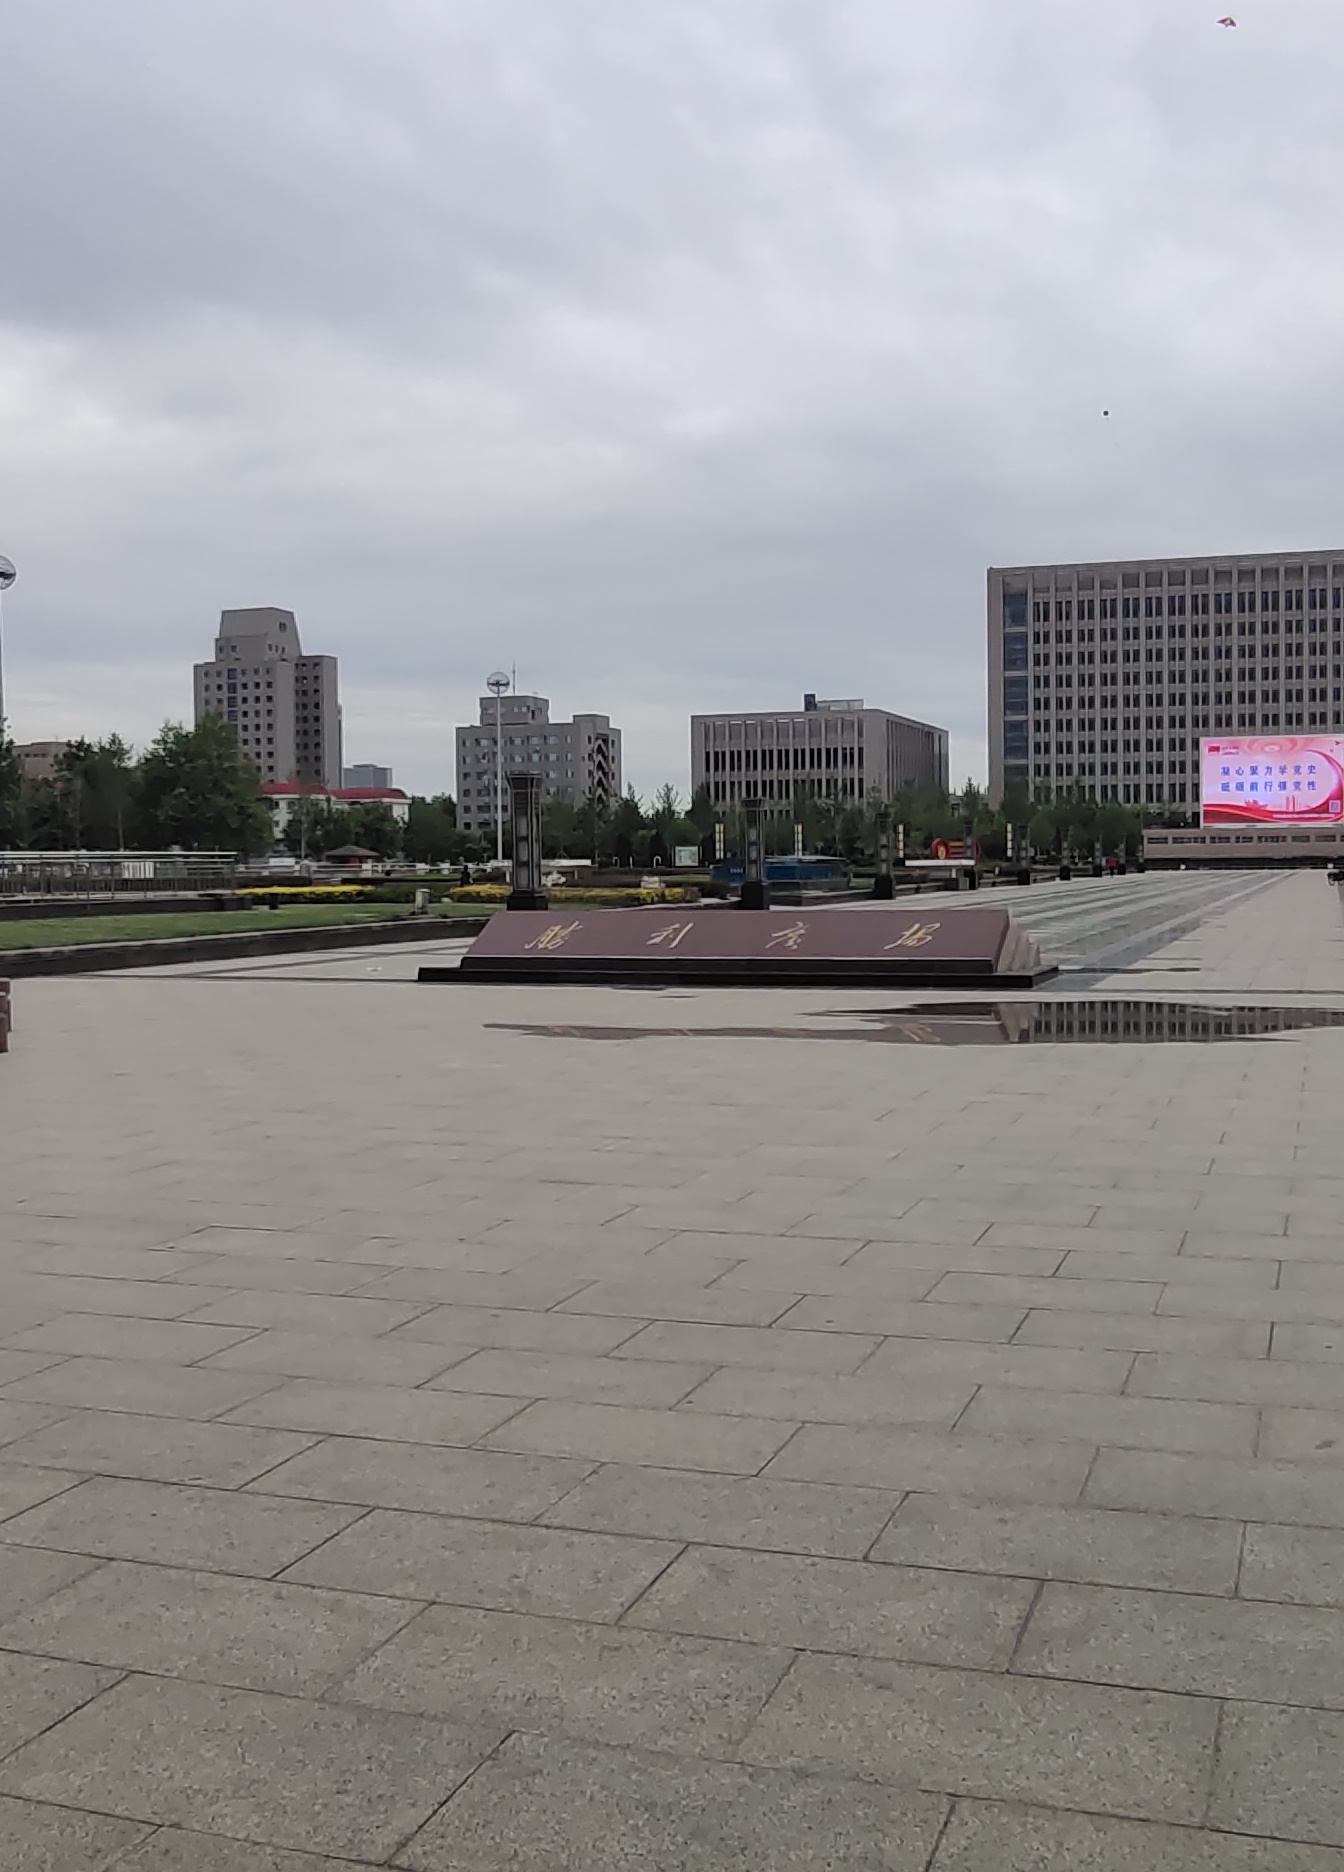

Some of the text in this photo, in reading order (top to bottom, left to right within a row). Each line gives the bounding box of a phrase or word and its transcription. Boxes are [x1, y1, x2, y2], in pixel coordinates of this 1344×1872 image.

[1221, 764, 1317, 776] 凝心聚力学党史
